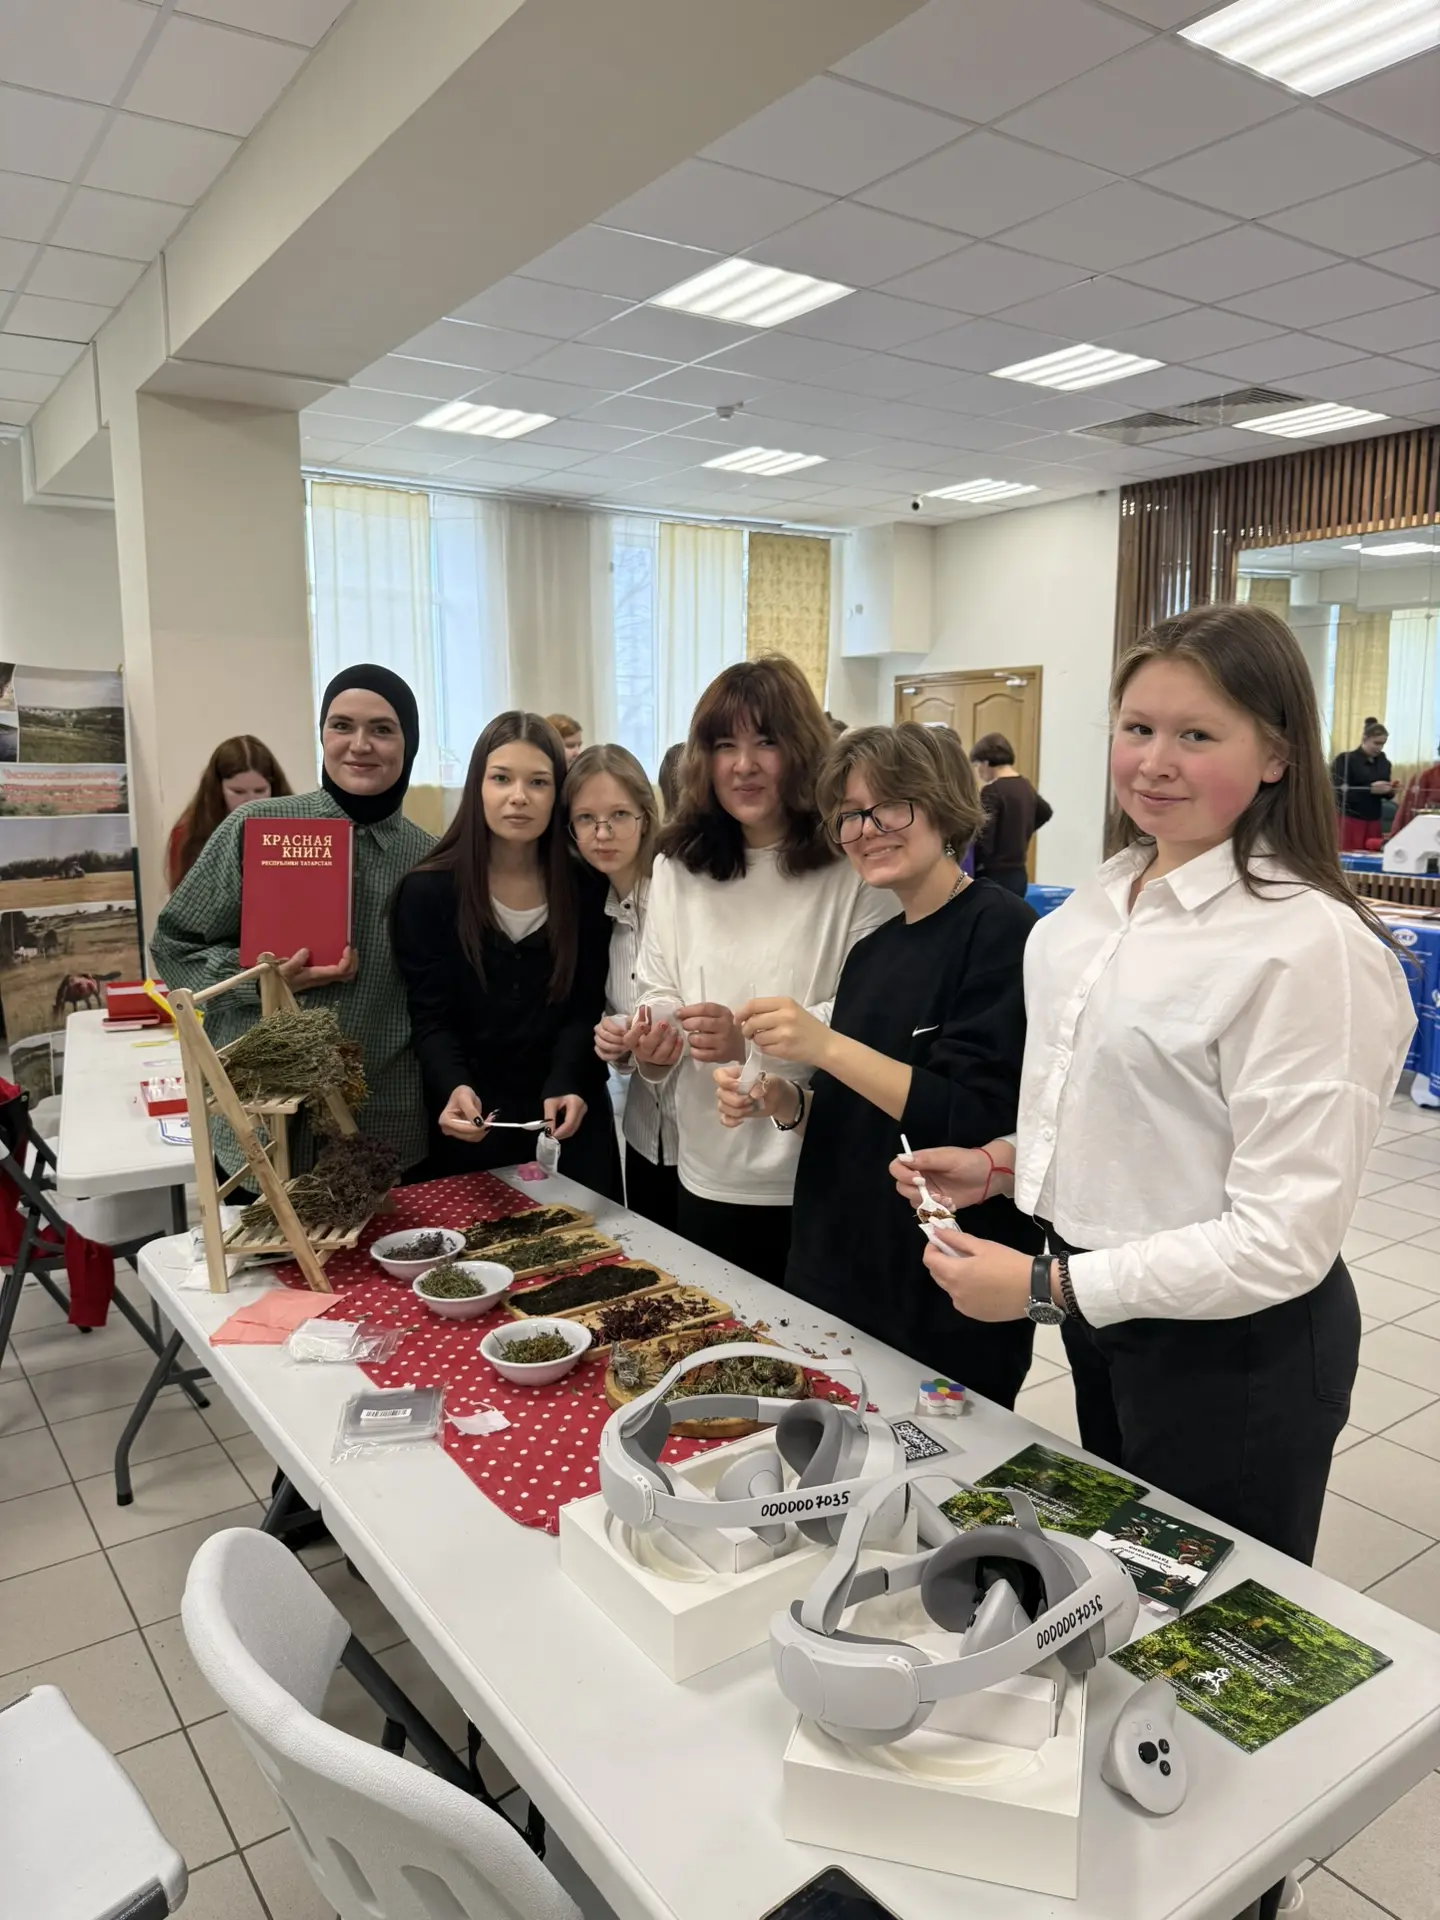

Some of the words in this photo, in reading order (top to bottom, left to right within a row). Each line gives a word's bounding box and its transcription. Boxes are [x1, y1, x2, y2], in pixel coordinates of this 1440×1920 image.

[262, 834, 332, 846] КРАСНАЯ
[282, 846, 332, 858] КНИГА
[761, 1491, 851, 1517] 0000007035
[1128, 1545, 1170, 1564] Татарстана
[1036, 1594, 1103, 1650] 0000007036
[1202, 1640, 1281, 1690] Заповедные
[1207, 1631, 1295, 1686] территории
